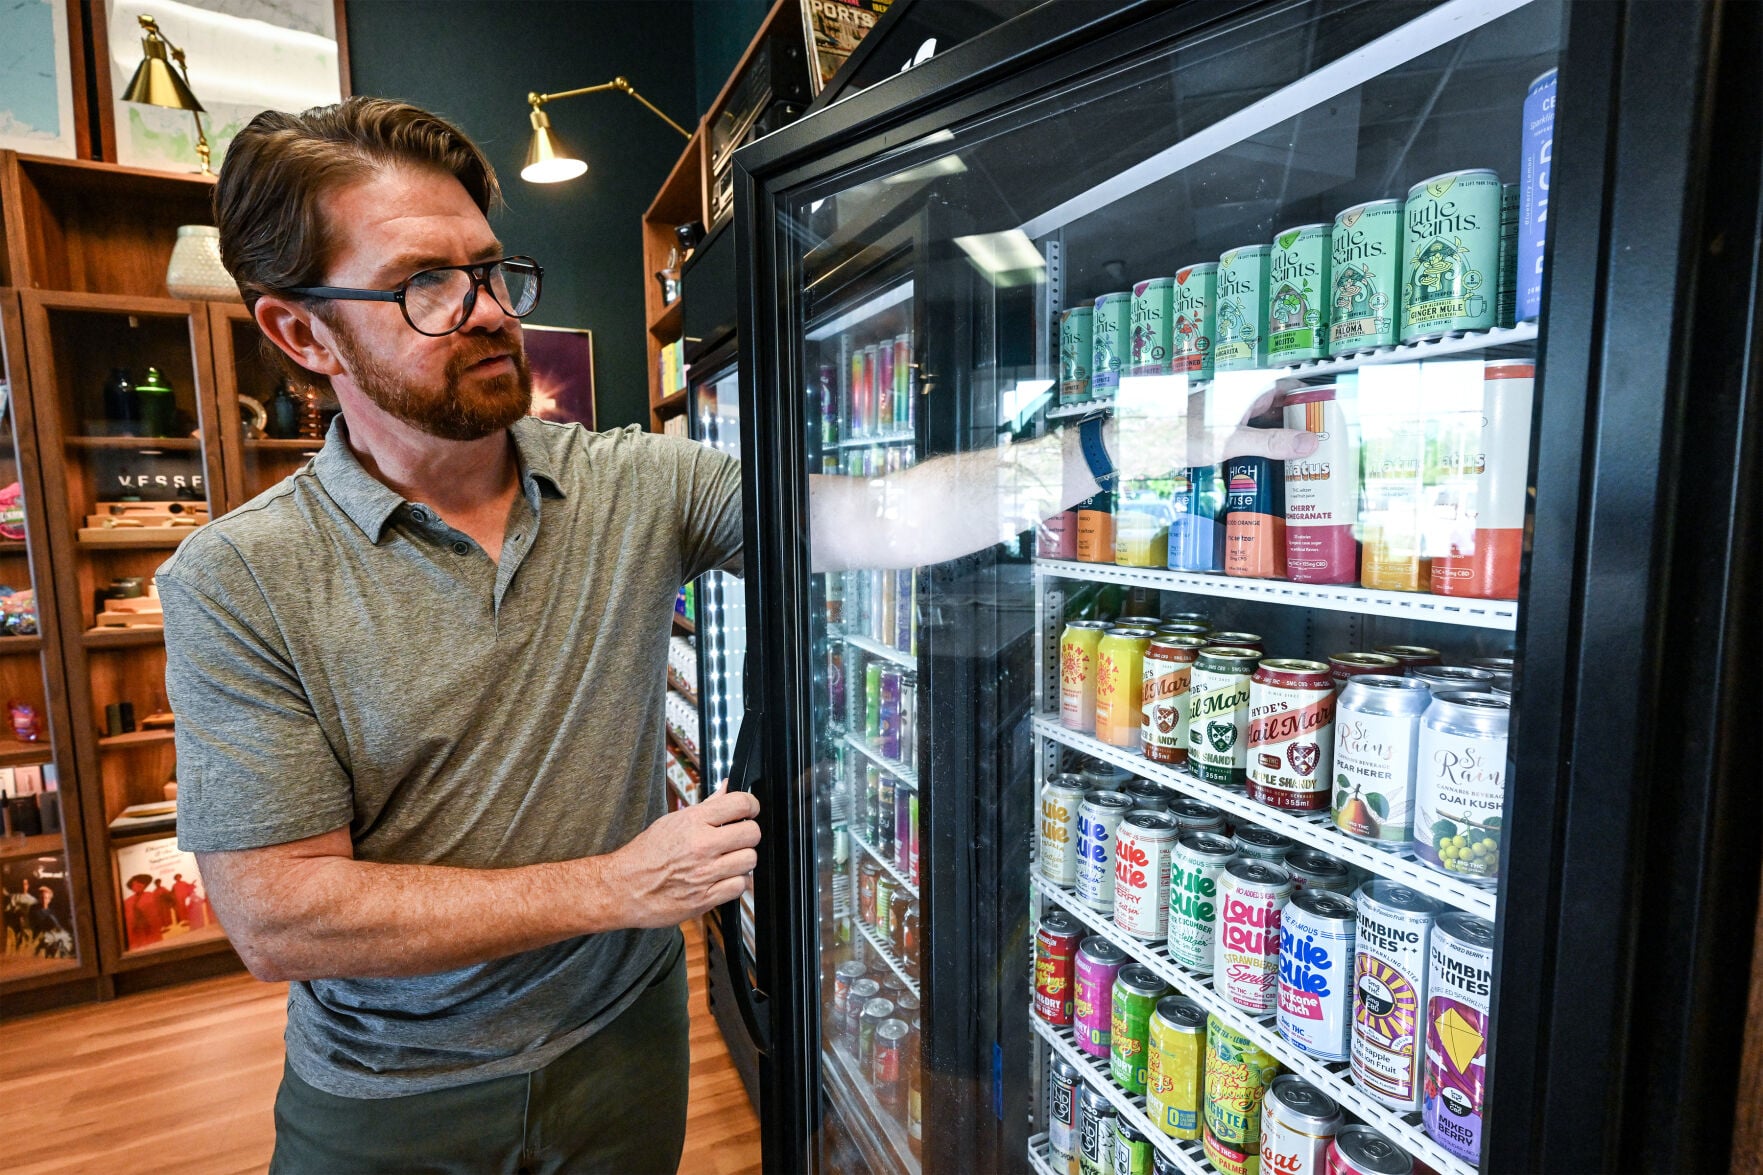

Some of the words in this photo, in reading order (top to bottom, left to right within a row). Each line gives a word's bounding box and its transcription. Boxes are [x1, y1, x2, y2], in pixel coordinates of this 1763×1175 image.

[1409, 199, 1457, 230] Little
[1410, 306, 1437, 319] GINGER
[1439, 303, 1463, 314] MULE
[1336, 324, 1363, 336] PALOMA
[1274, 337, 1295, 347] MOJITO
[1230, 465, 1258, 481] HIGH
[1229, 493, 1253, 506] rise
[1290, 504, 1316, 512] CHERRY
[1251, 701, 1288, 719] HYDE'S
[1338, 722, 1393, 761] Rains
[1202, 752, 1236, 766] SHANDY
[1205, 771, 1227, 781] 355ml
[1337, 759, 1355, 773] PEAR
[1356, 767, 1393, 780] HERER
[1279, 776, 1318, 790] SHANDY
[1436, 783, 1470, 796] CANNABIS
[1285, 799, 1309, 807] 355ml
[1439, 792, 1466, 806] OJAI
[1469, 799, 1504, 810] KUSH
[1358, 823, 1369, 831] THC
[1243, 888, 1259, 898] ADDED
[1223, 893, 1281, 929] Louie
[1222, 921, 1281, 957] Louie
[1360, 926, 1399, 953] KITES
[1449, 943, 1466, 954] MIXED
[1465, 949, 1485, 960] BERRY
[1369, 946, 1402, 968] SPARKLING
[1401, 965, 1419, 983] WATER
[1226, 963, 1277, 992] Spritz
[1441, 967, 1490, 997] KITES
[1236, 987, 1247, 995] THC
[1368, 985, 1380, 996] THC
[1066, 1002, 1073, 1016] 0
[1367, 1002, 1380, 1012] CBD
[1091, 1029, 1100, 1045] 0
[1220, 1028, 1230, 1039] TEA
[1233, 1035, 1251, 1046] LEMON
[1292, 1024, 1305, 1037] THC
[1376, 1061, 1397, 1075] Fruit
[1138, 1069, 1148, 1084] 0
[1169, 1108, 1180, 1126] 0
[1226, 1111, 1249, 1130] TEA
[1439, 1114, 1473, 1138] MIXED
[1438, 1122, 1473, 1147] BERRY
[1221, 1146, 1233, 1159] THC
[1218, 1157, 1248, 1175] PALMER
